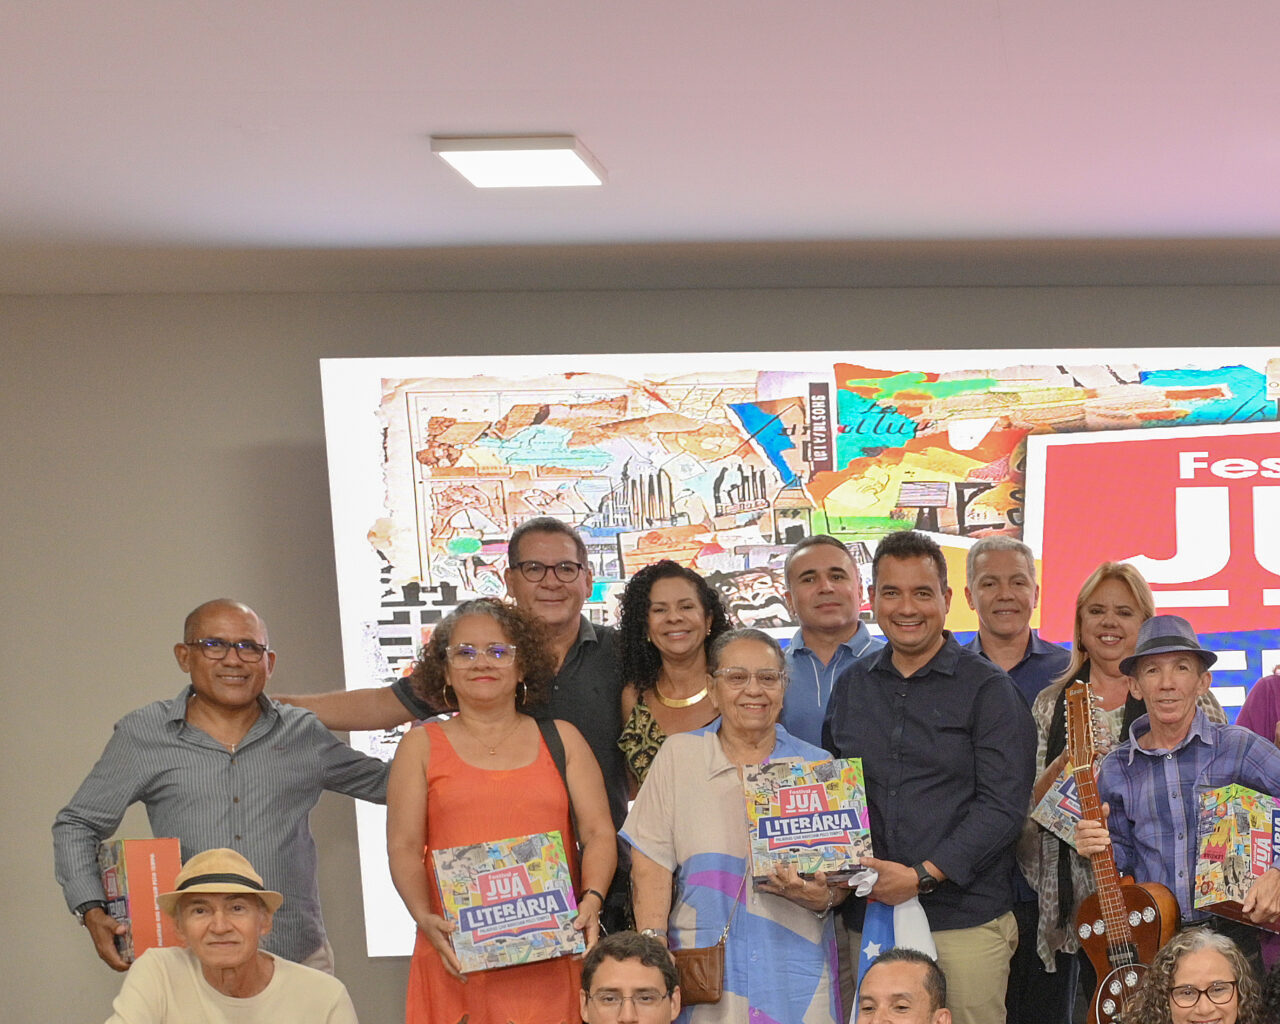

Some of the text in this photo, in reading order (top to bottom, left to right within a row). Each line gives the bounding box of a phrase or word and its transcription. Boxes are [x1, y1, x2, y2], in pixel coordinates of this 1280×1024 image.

[786, 790, 823, 813] JUÁ
[765, 813, 853, 836] LITERÁRIA
[1255, 838, 1272, 871] JUÁ
[486, 873, 527, 900] JUÁ
[466, 895, 560, 928] LITERÁRIA
